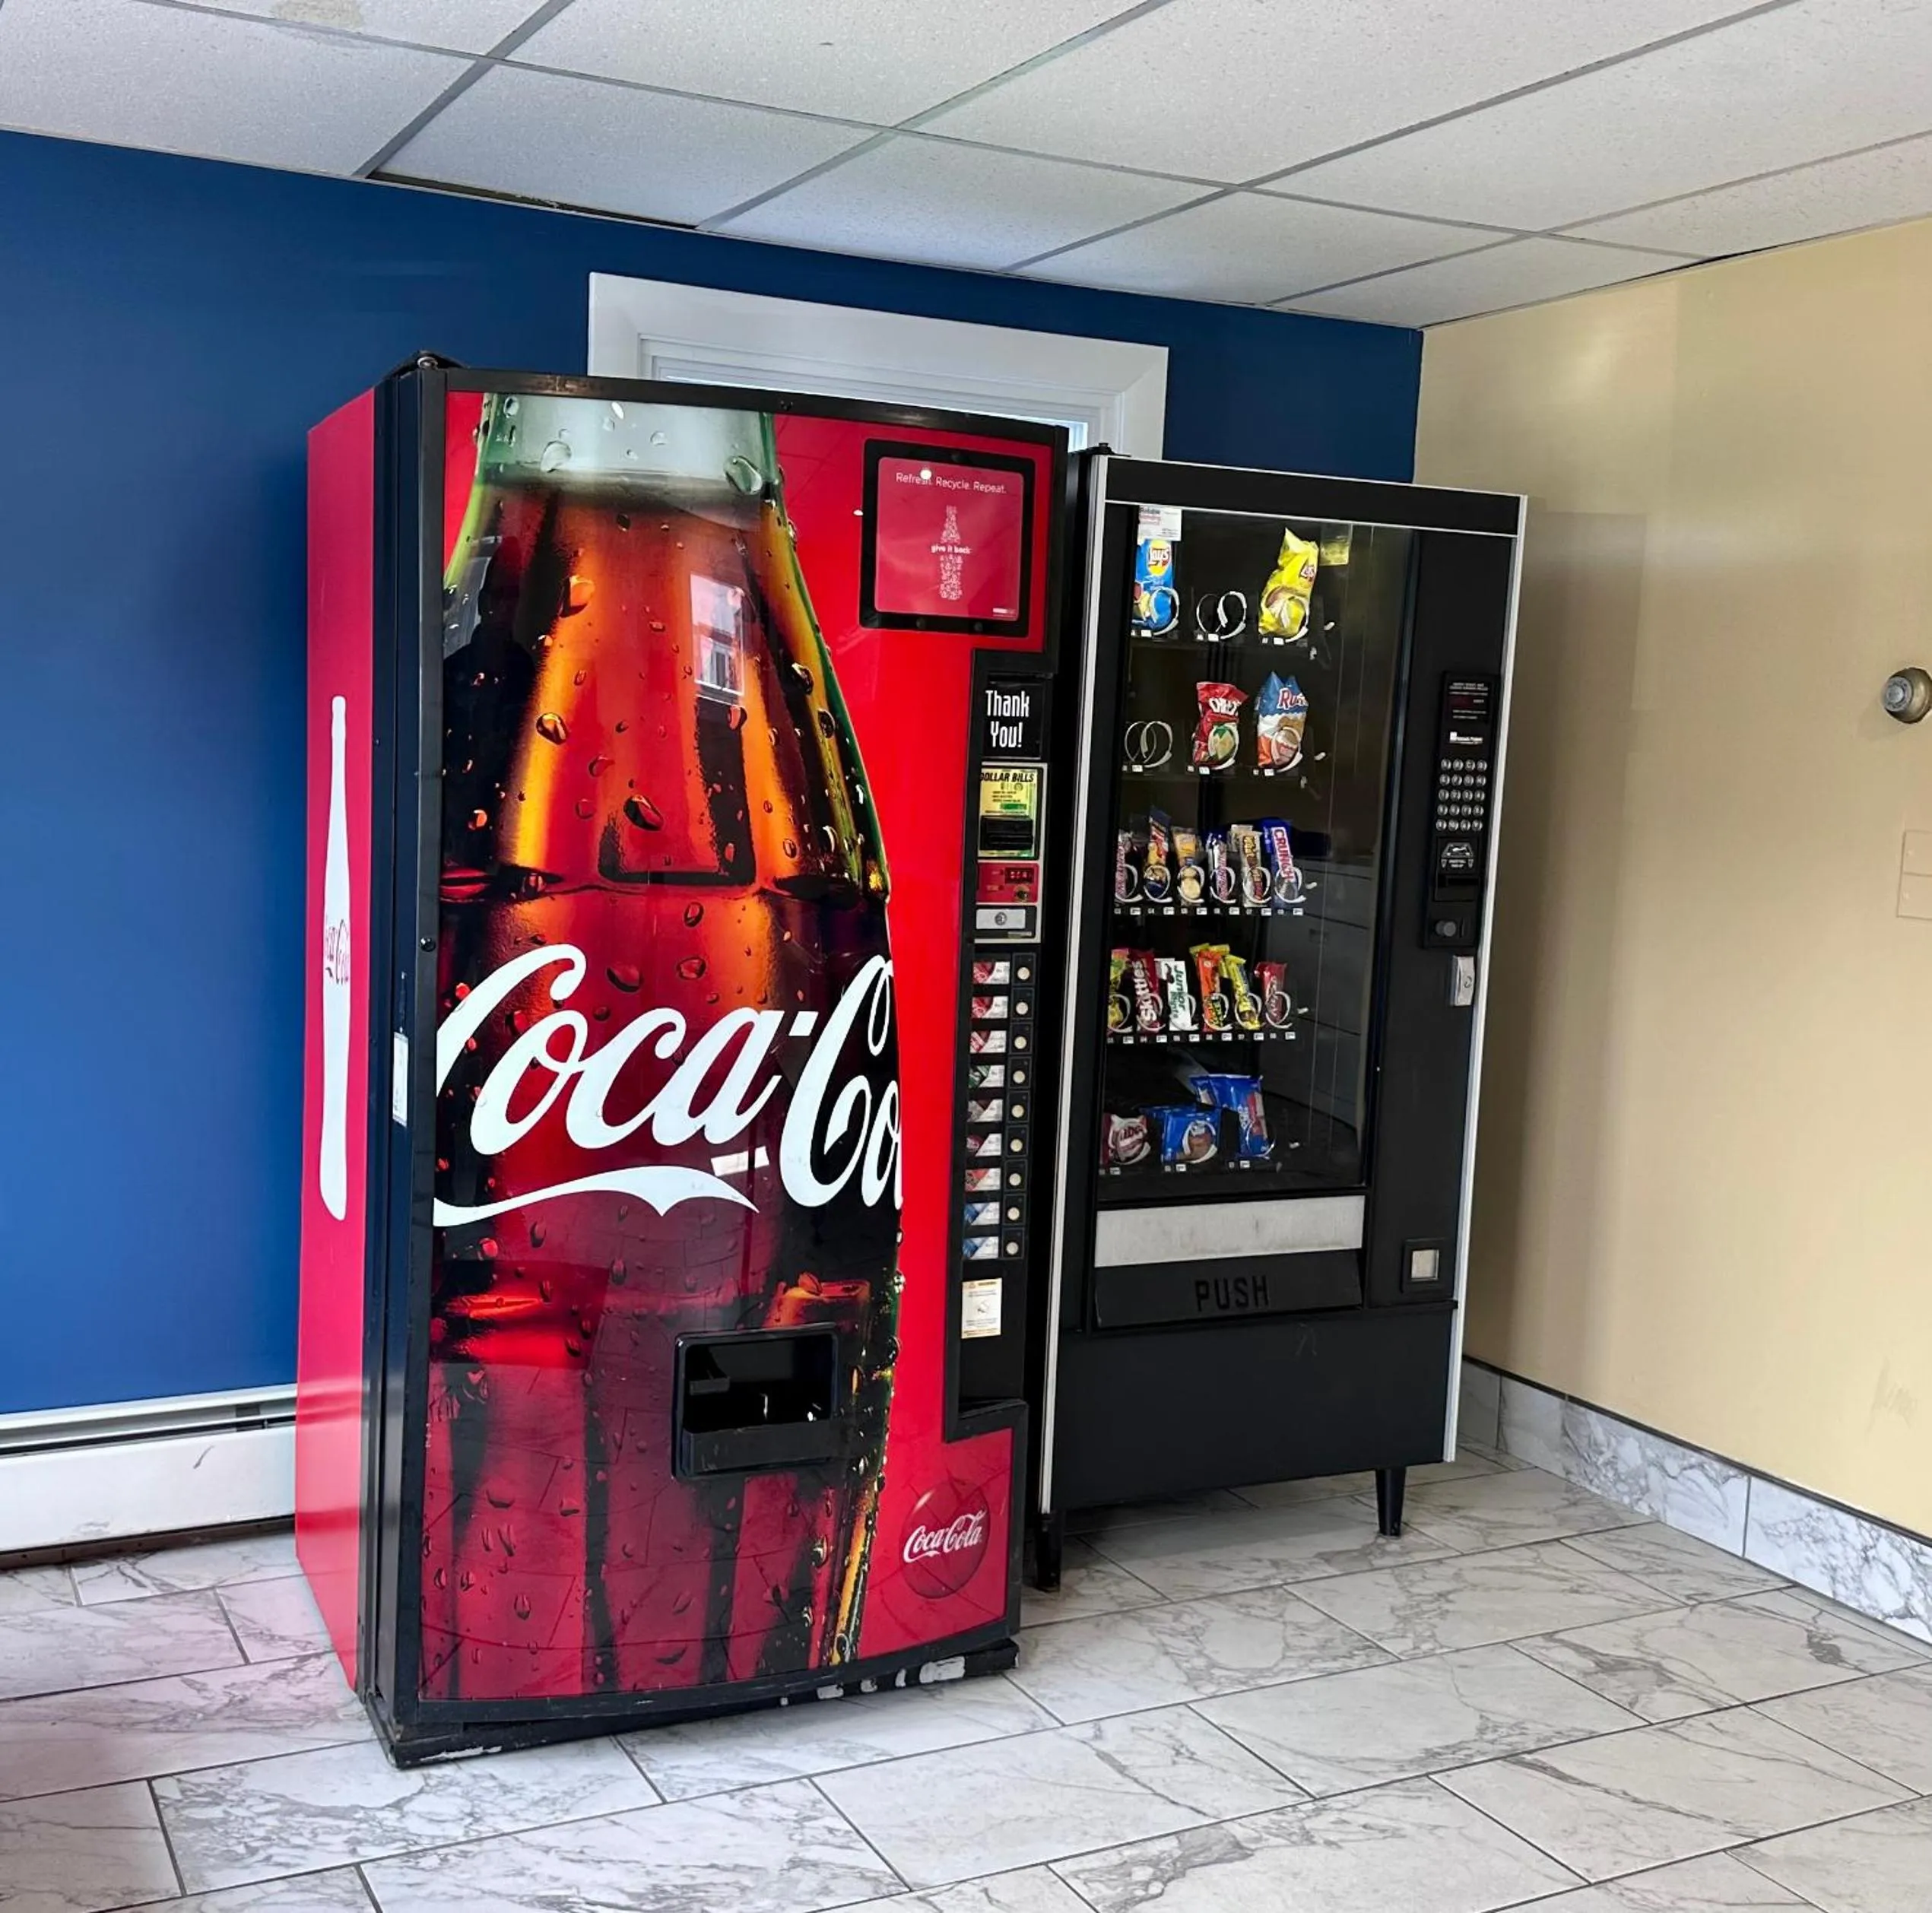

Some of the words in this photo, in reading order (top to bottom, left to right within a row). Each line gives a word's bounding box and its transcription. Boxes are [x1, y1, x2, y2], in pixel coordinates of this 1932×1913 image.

[973, 481, 1007, 493] Repeat.
[985, 690, 1030, 718] Thank
[990, 720, 1023, 748] You!
[980, 772, 1010, 782] DOLLAR
[1011, 772, 1035, 782] BILLS
[433, 943, 903, 1227] Coca-Co
[1194, 1274, 1270, 1312] PUSH
[903, 1509, 988, 1564] Coca-Cola
